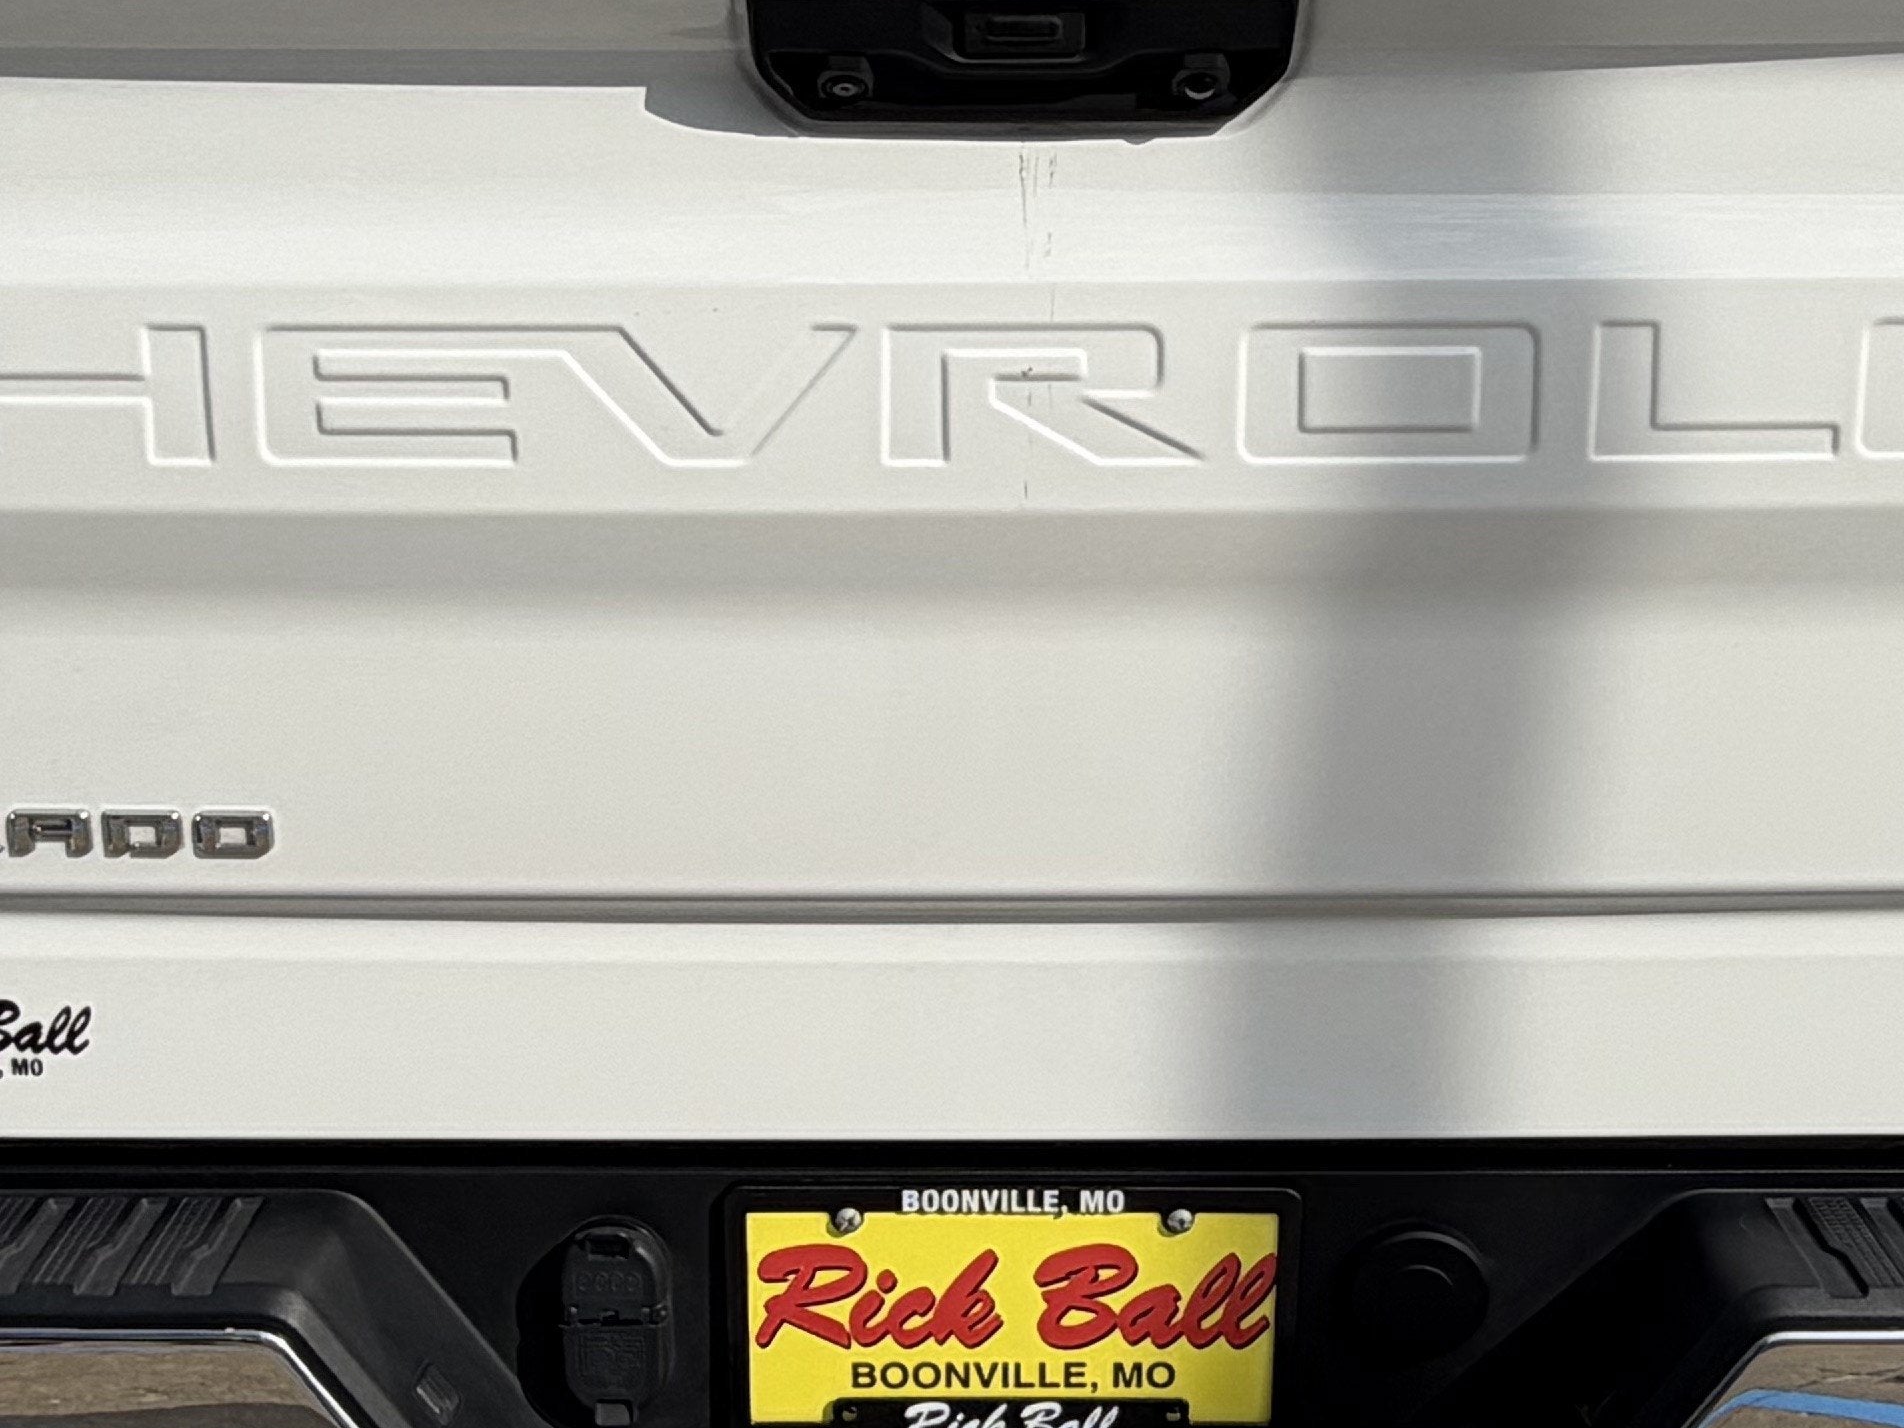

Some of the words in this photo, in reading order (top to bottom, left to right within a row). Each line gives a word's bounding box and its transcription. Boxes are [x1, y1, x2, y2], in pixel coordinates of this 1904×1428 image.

[11, 1058, 43, 1077] MO
[901, 1188, 1068, 1214] BOONVILLE,
[1079, 1189, 1126, 1213] MO
[755, 1243, 1003, 1350] Rick
[1033, 1243, 1277, 1350] Ball
[851, 1361, 1099, 1393] BOONVILLE,
[1112, 1361, 1176, 1390] MO
